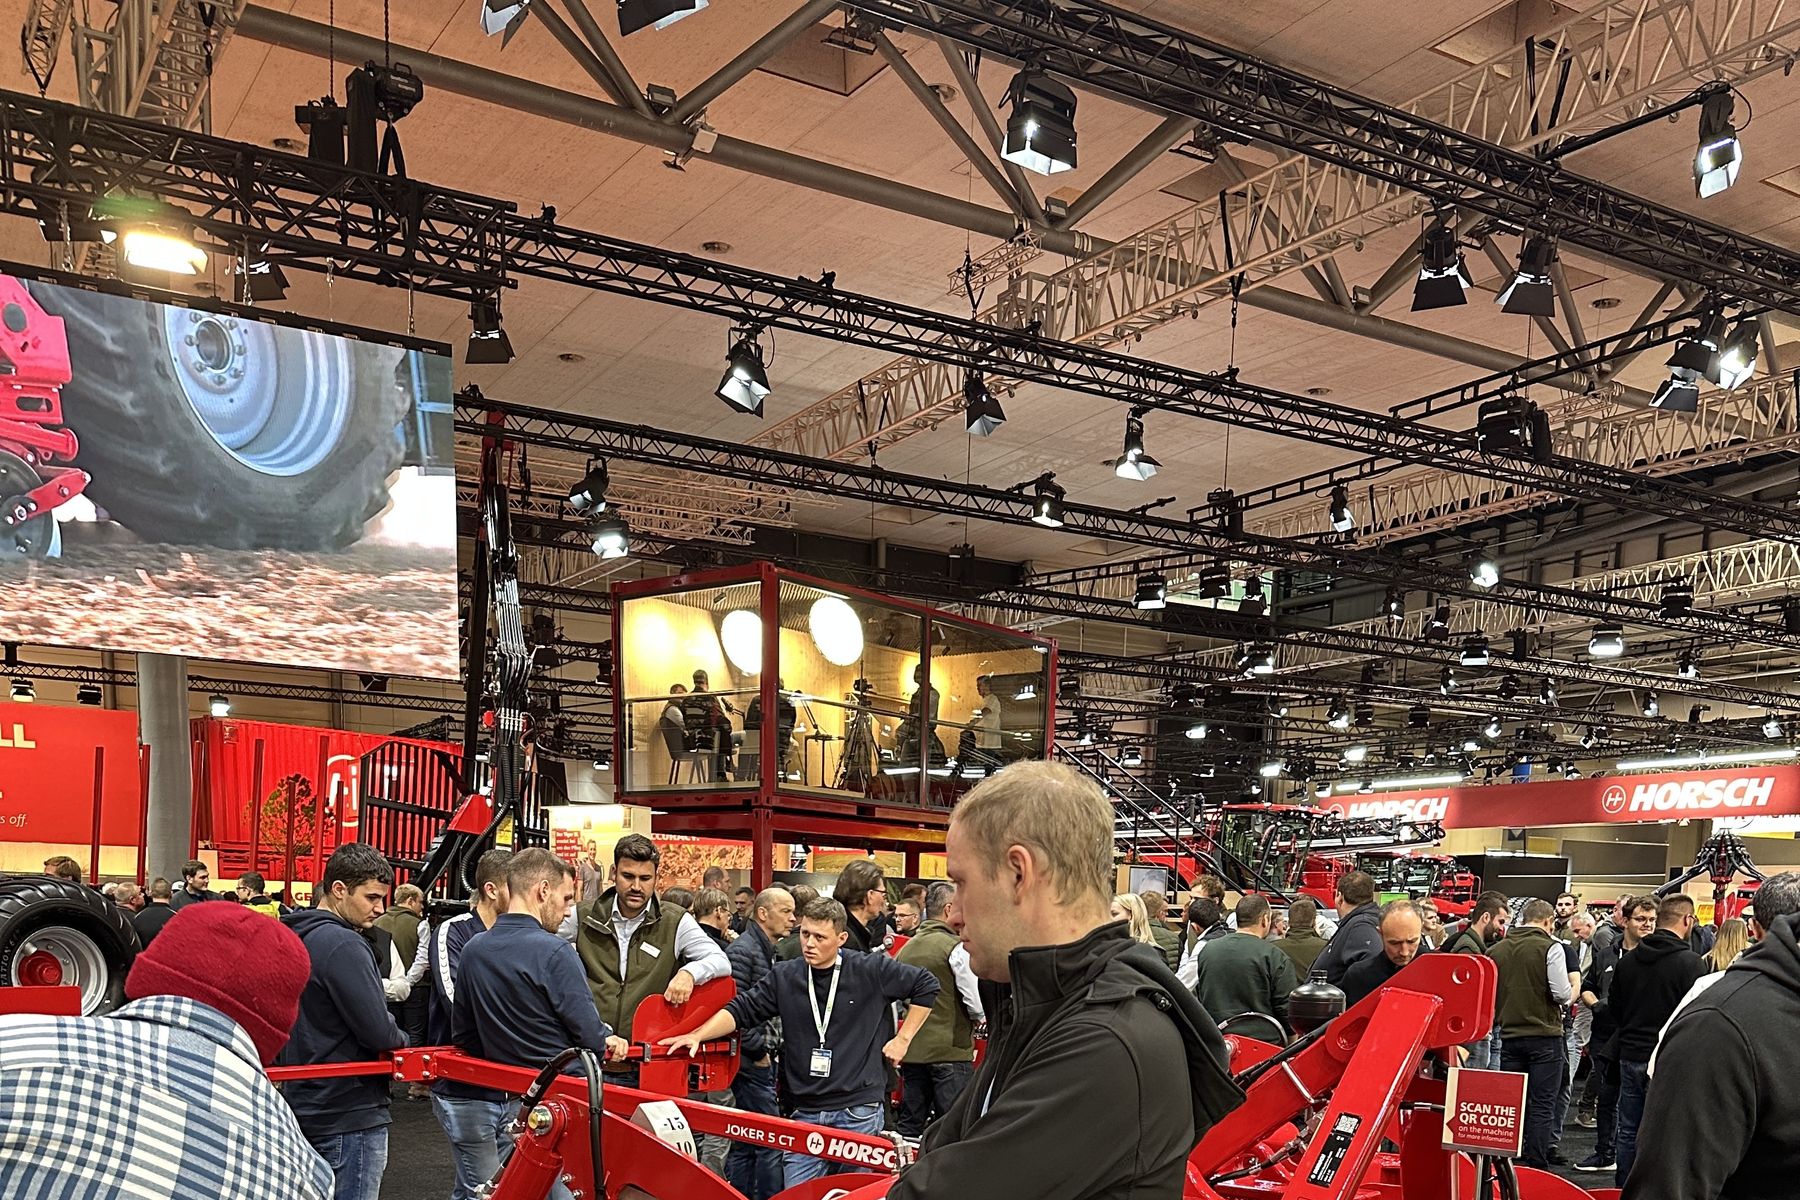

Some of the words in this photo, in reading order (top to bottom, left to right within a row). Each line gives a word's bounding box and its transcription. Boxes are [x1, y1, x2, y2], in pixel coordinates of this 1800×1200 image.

[1629, 777, 1776, 812] HORSCH
[9, 813, 28, 828] off.
[1460, 1102, 1491, 1114] SCAN
[1494, 1105, 1516, 1116] THE
[1459, 1113, 1477, 1125] QR
[1480, 1115, 1515, 1128] CODE
[725, 1123, 764, 1141] JOKER
[768, 1132, 776, 1143] 5
[778, 1135, 795, 1147] CT
[1469, 1126, 1481, 1134] the
[1483, 1128, 1514, 1137] machine
[1481, 1134, 1514, 1143] information
[827, 1138, 899, 1169] HORSC
